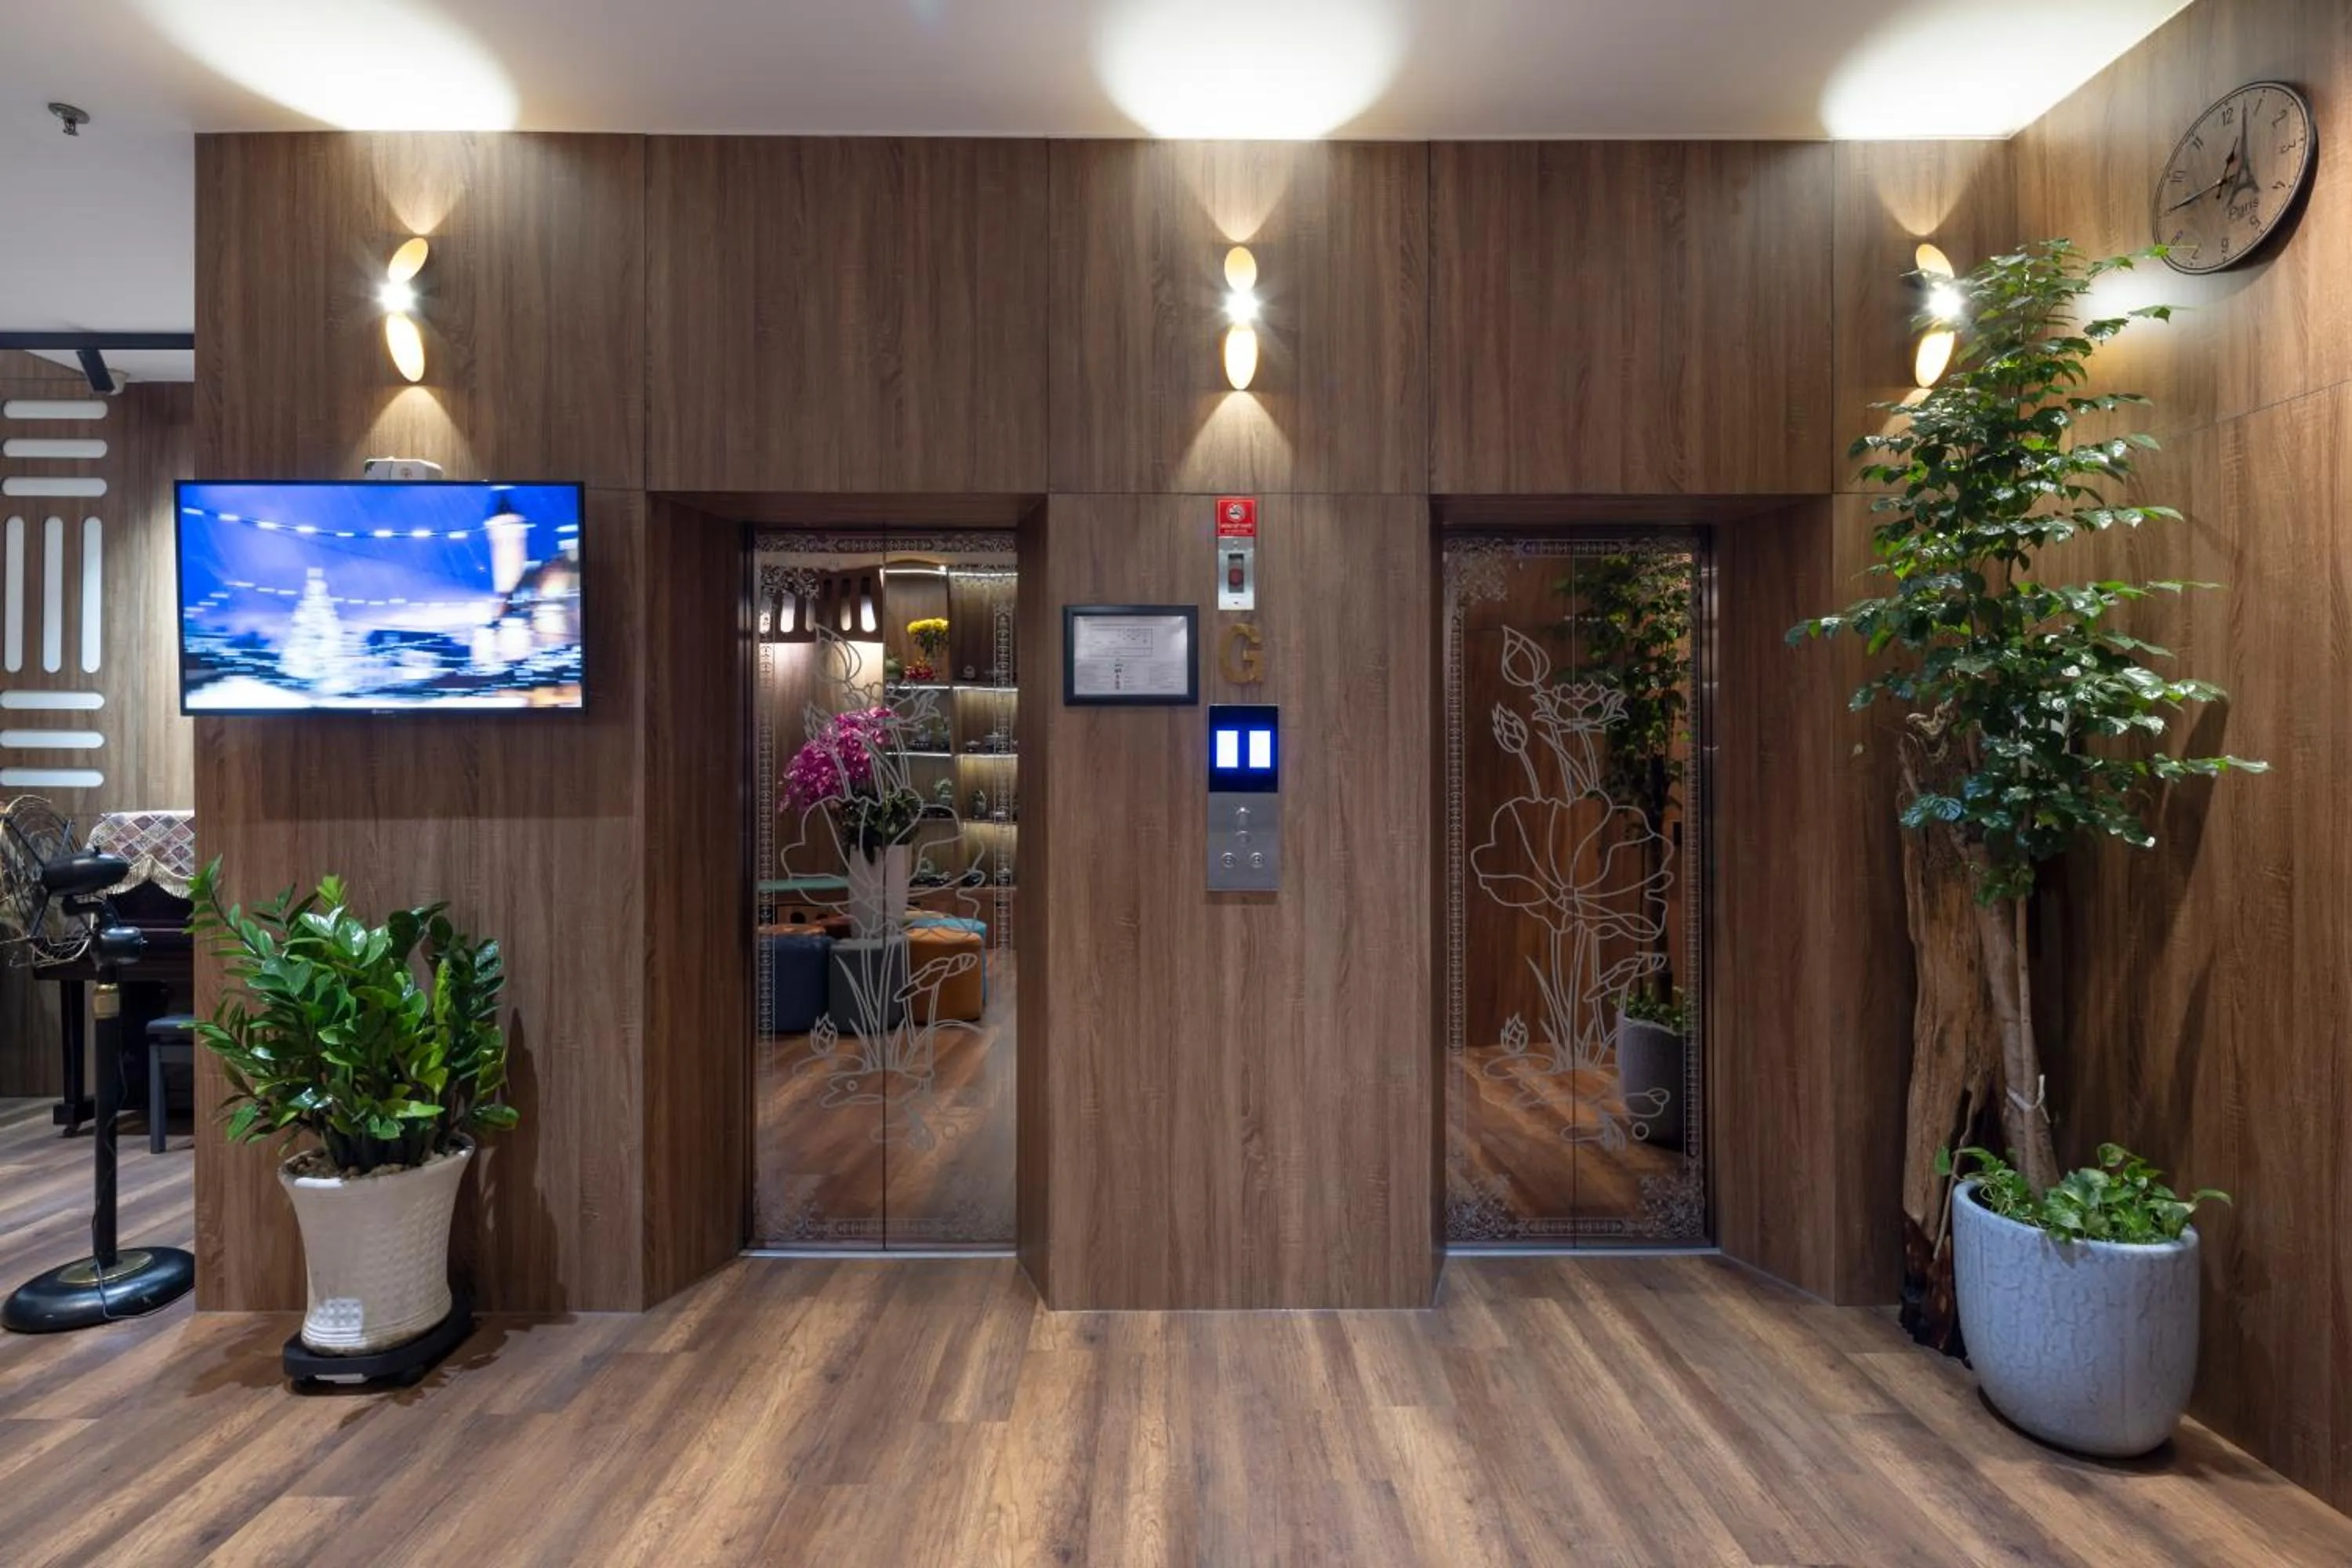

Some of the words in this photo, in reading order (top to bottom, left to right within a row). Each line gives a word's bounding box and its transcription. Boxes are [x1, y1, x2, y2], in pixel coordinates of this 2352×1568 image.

[2221, 107, 2233, 126] 12
[2272, 109, 2288, 128] 2
[2280, 139, 2296, 154] 3
[2170, 169, 2186, 183] 10
[1219, 623, 1263, 684] G
